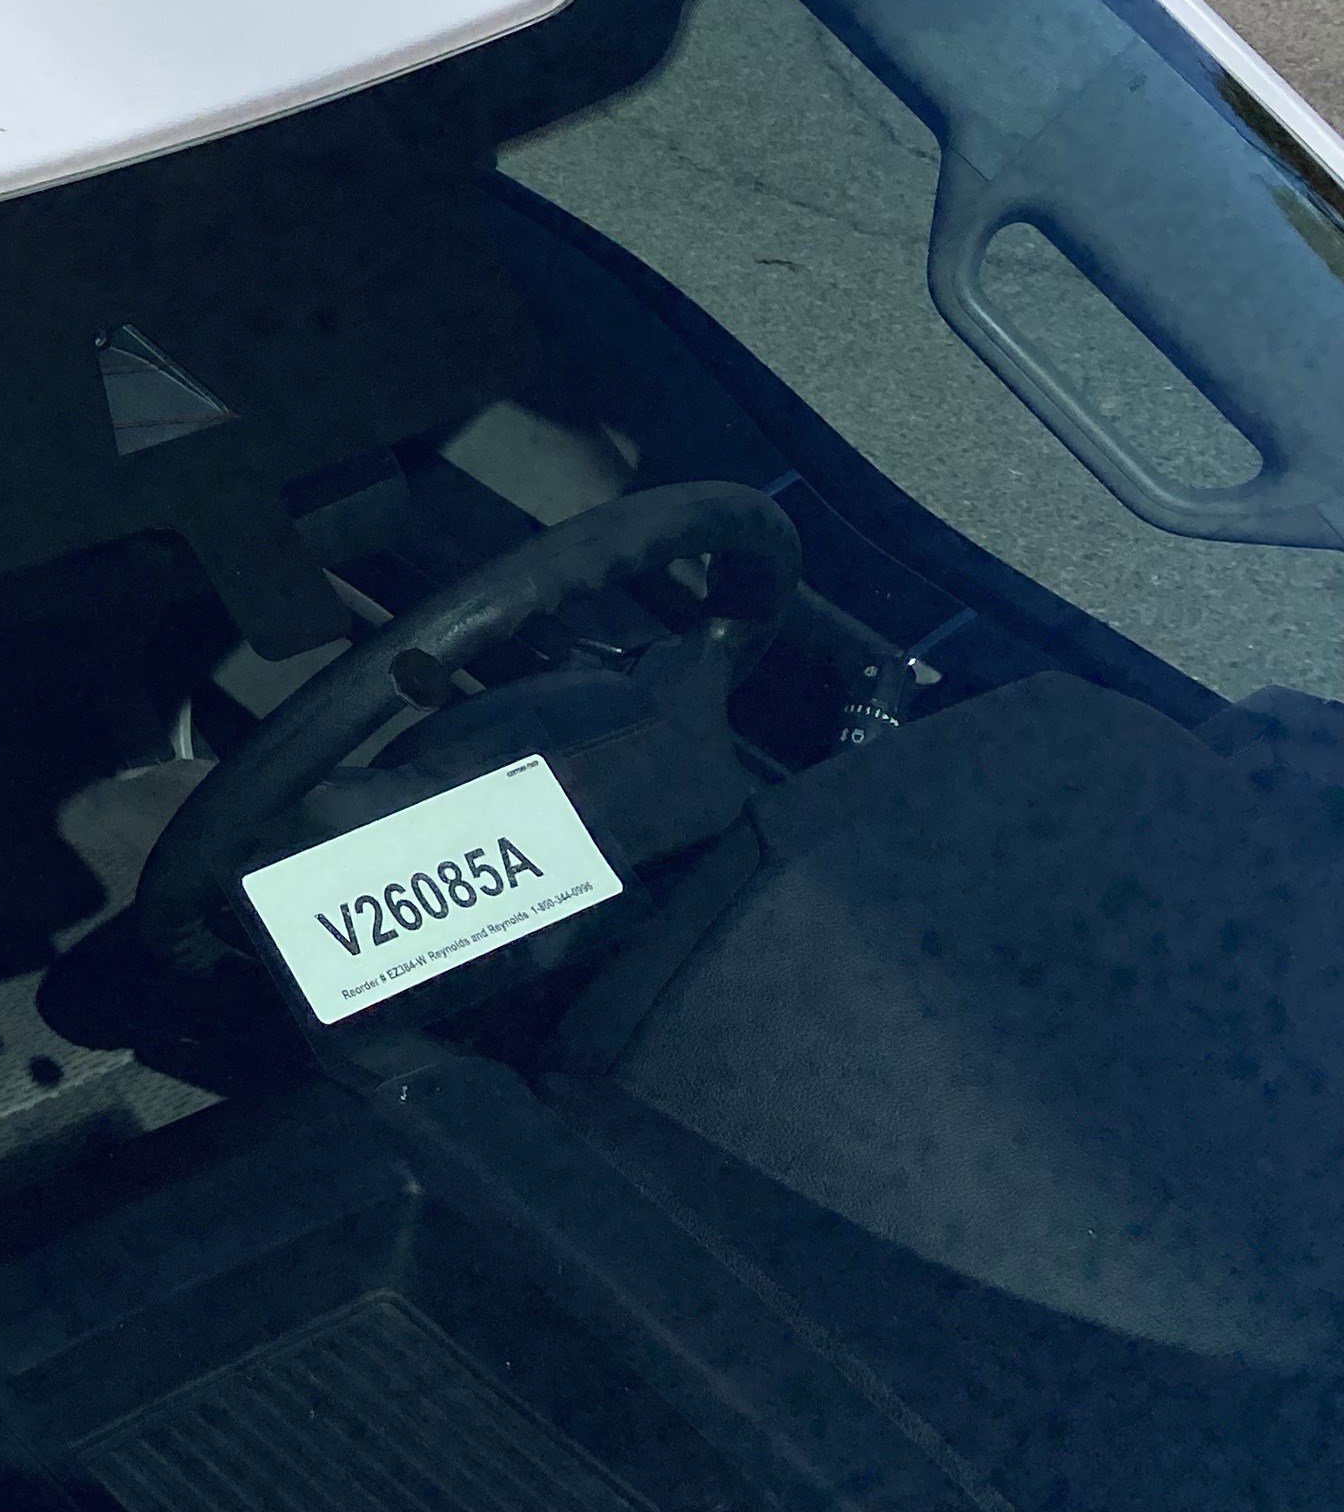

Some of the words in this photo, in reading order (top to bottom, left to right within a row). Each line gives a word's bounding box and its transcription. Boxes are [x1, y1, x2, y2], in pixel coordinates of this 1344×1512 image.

[314, 836, 544, 956] V26085A
[341, 977, 380, 1000] Reorder
[427, 936, 471, 961] Reynolds
[471, 928, 489, 942] and
[487, 911, 530, 934] Reynolds
